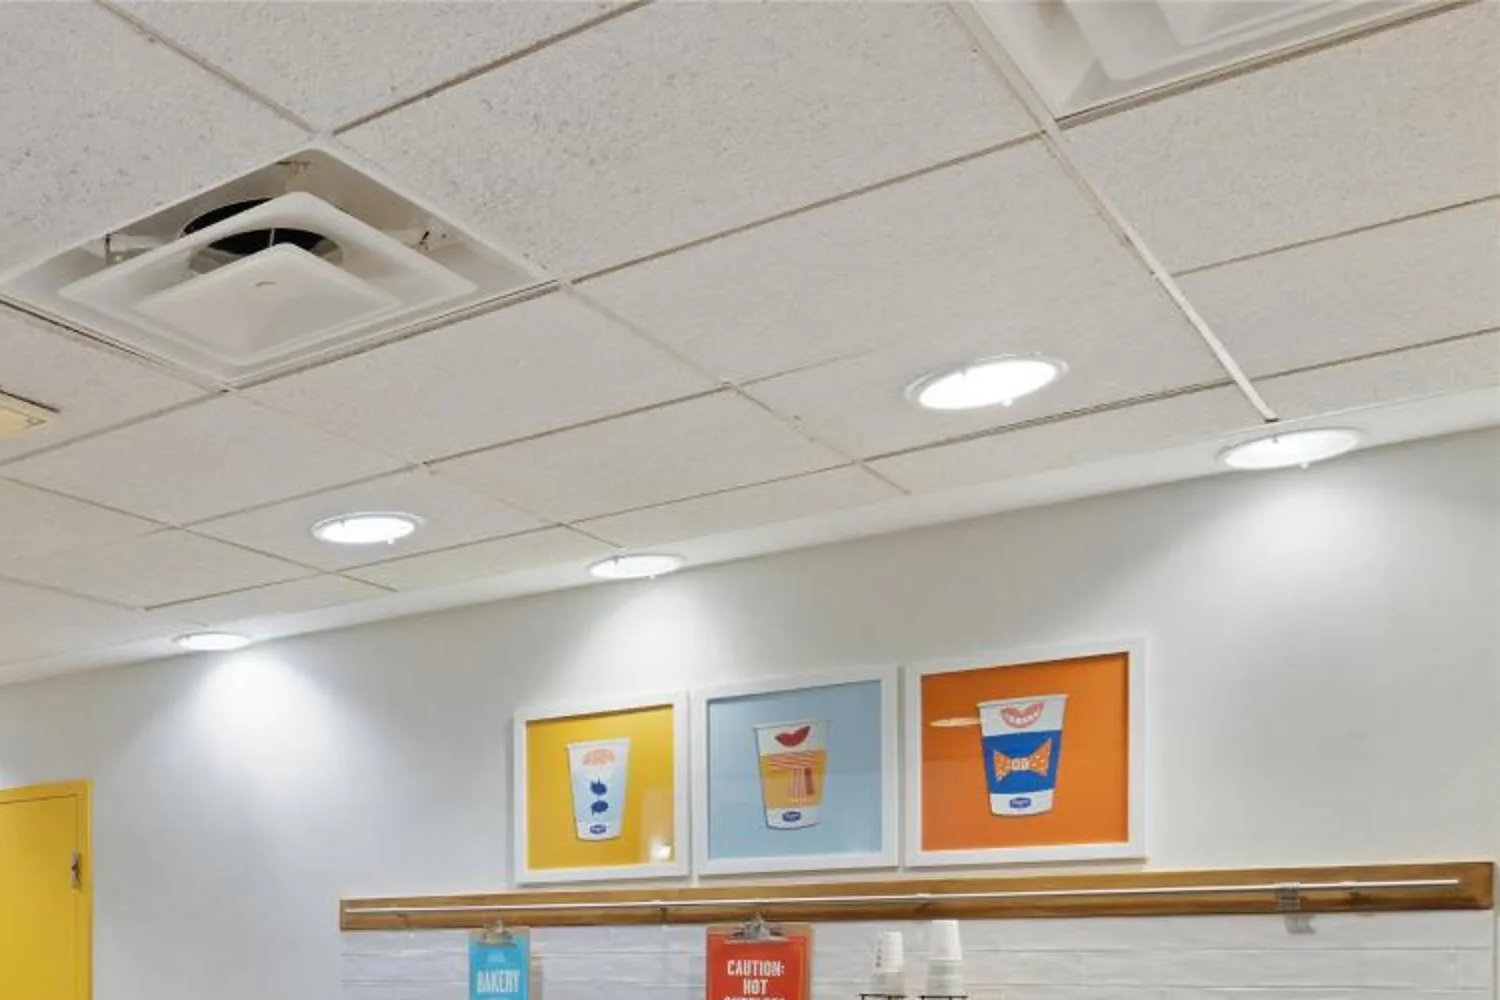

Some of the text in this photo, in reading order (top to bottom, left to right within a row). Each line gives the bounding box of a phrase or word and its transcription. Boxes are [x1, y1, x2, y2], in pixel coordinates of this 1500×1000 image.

[727, 959, 785, 976] CAUTION:
[477, 969, 520, 993] BAKERY
[743, 978, 768, 995] HOT
